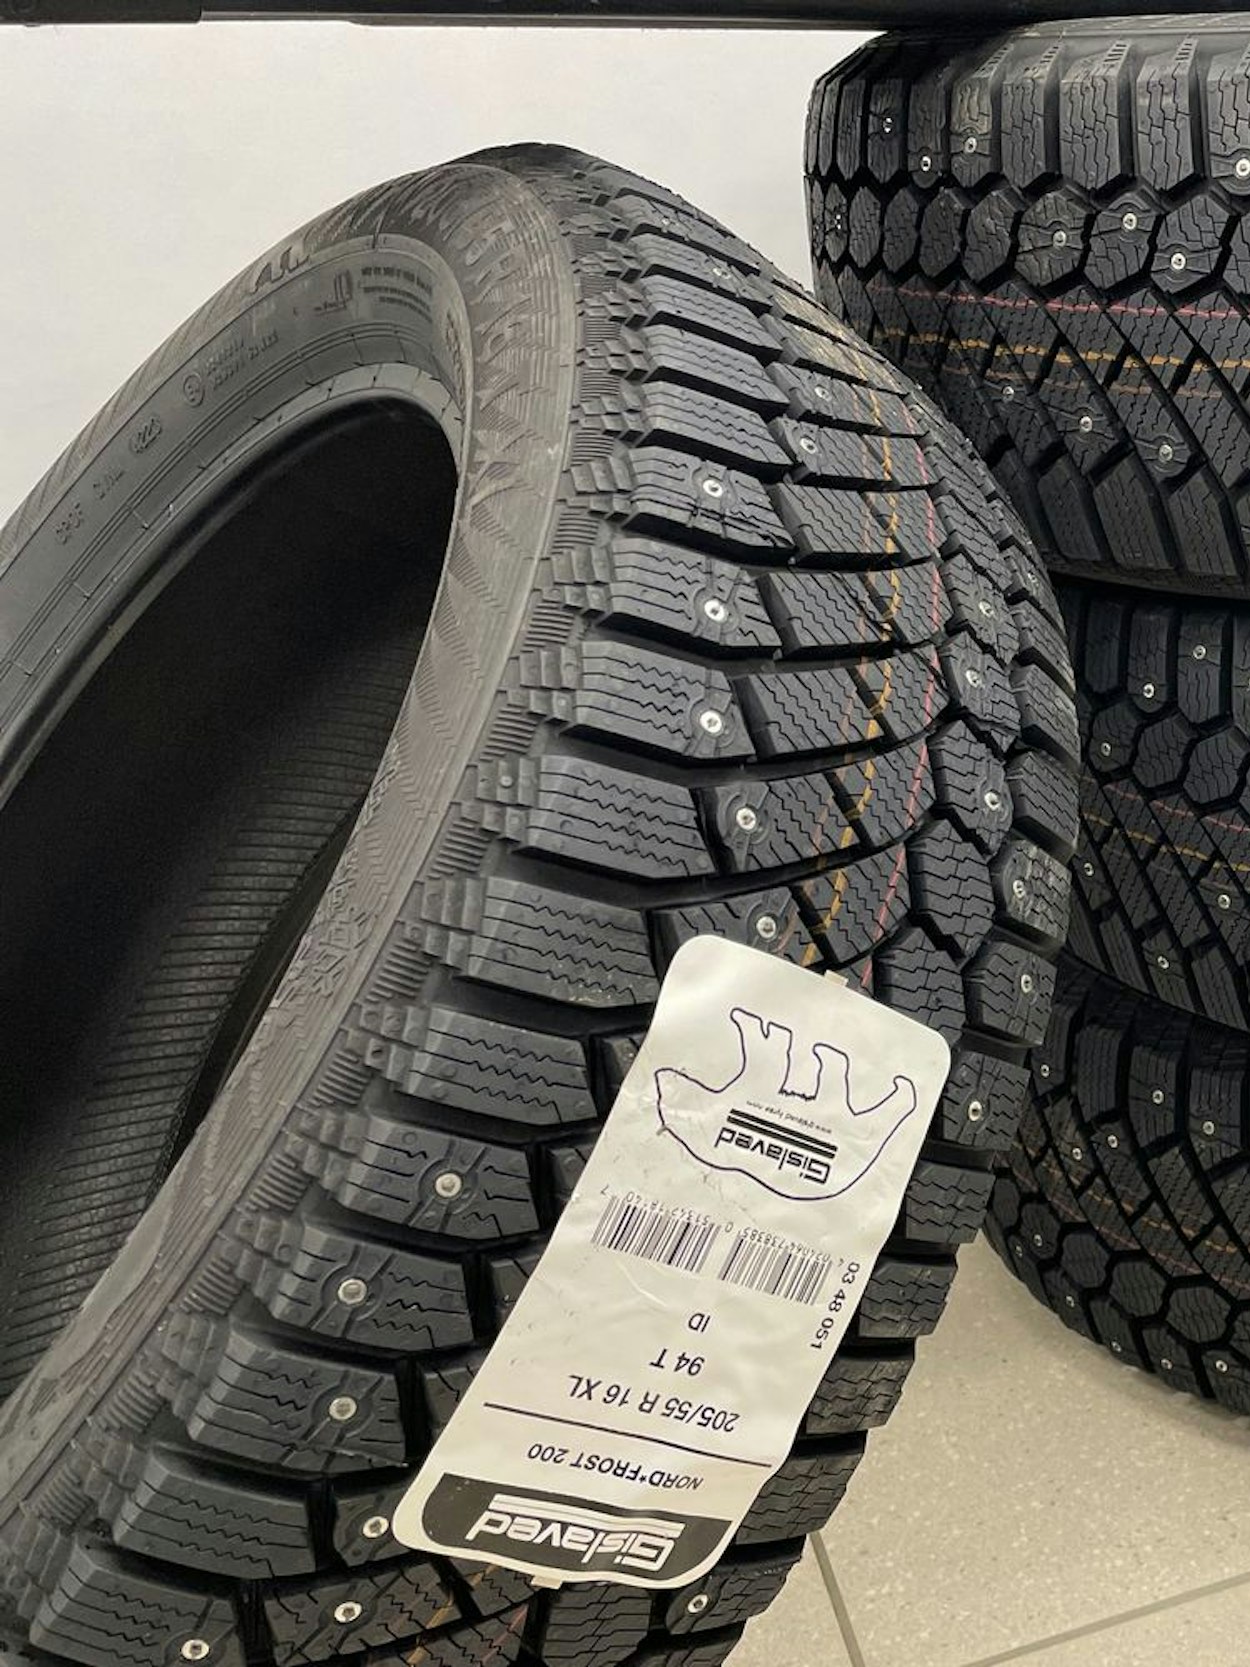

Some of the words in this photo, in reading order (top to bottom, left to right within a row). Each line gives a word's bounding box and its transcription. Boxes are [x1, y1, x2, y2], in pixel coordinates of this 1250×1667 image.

[714, 1127, 831, 1184] Gislaved
[600, 1184, 610, 1195] 7
[842, 1262, 860, 1284] 03
[828, 1289, 846, 1312] 48
[688, 1312, 711, 1332] ID
[810, 1317, 834, 1349] 051
[649, 1348, 667, 1369] T
[674, 1352, 705, 1376] 94
[569, 1375, 602, 1401] XL
[603, 1384, 632, 1408] 16
[638, 1391, 661, 1414] R
[661, 1397, 741, 1433] 205/55
[527, 1443, 570, 1464] 200
[464, 1510, 676, 1572] Gislaved
